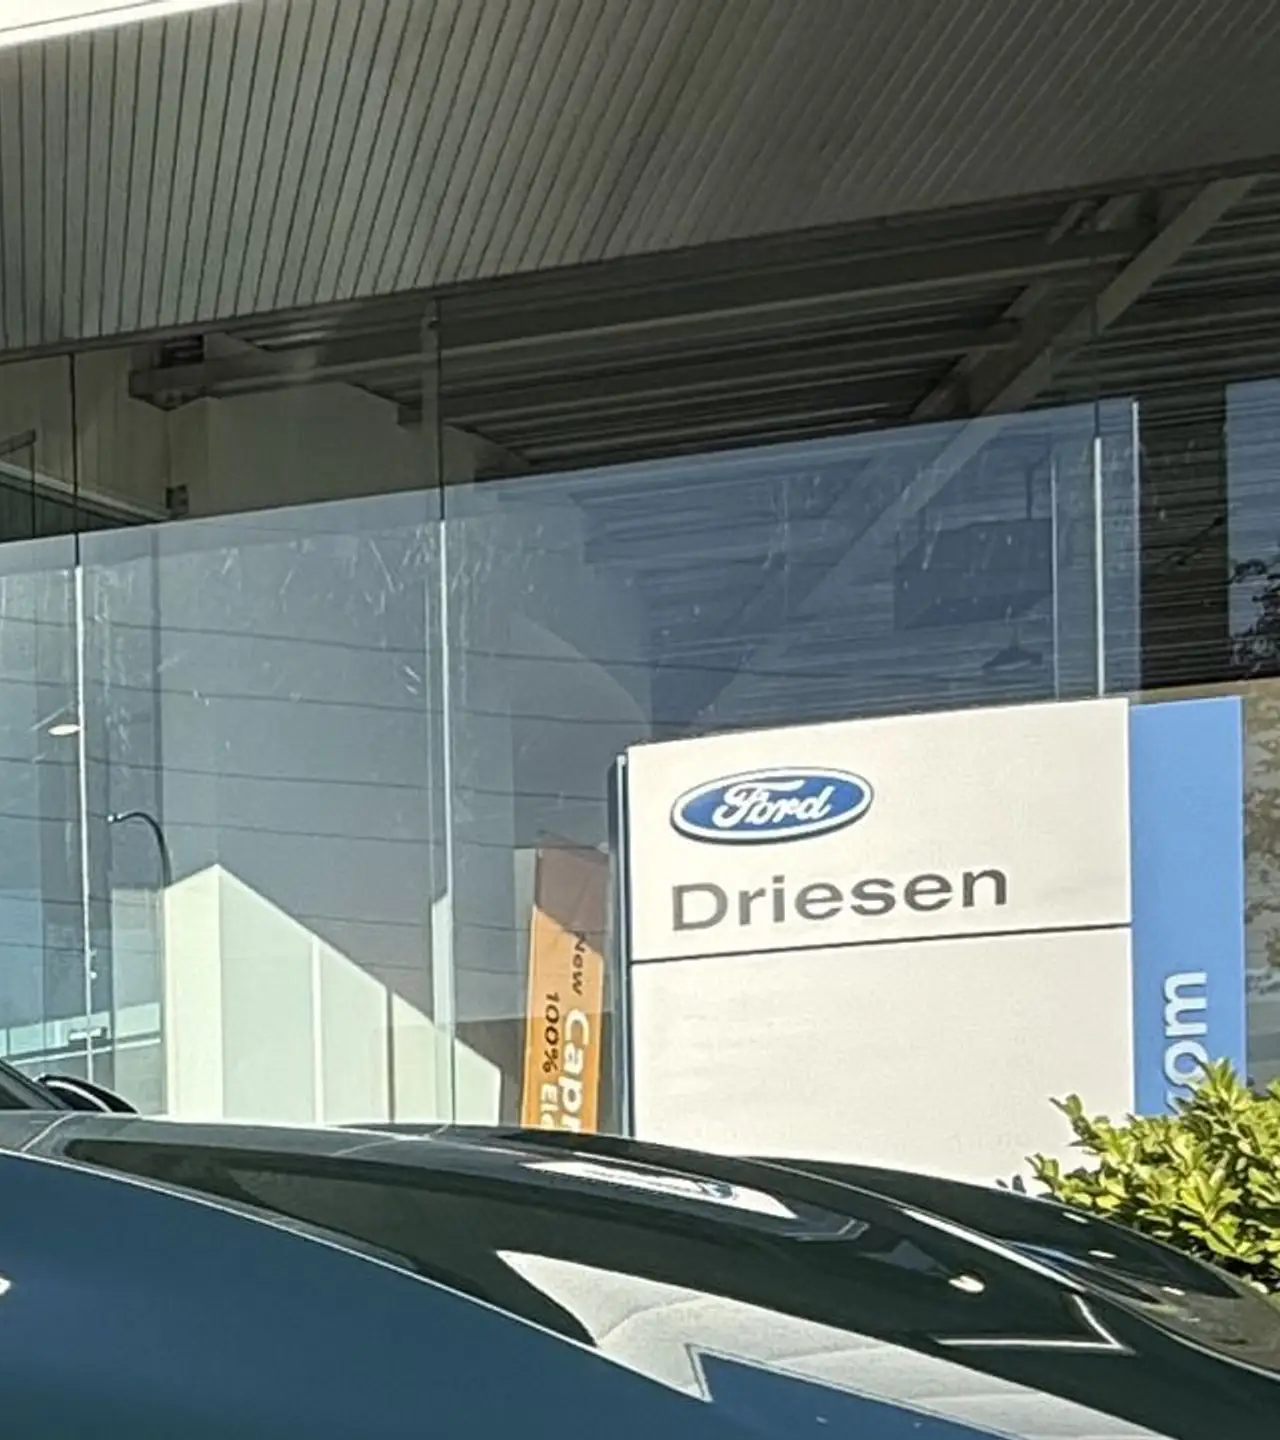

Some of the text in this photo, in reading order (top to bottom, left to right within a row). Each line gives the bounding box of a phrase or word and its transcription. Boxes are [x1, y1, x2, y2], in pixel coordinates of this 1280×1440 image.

[711, 778, 837, 829] Ford
[672, 867, 1008, 931] Driesen
[541, 991, 561, 1075] 100%
